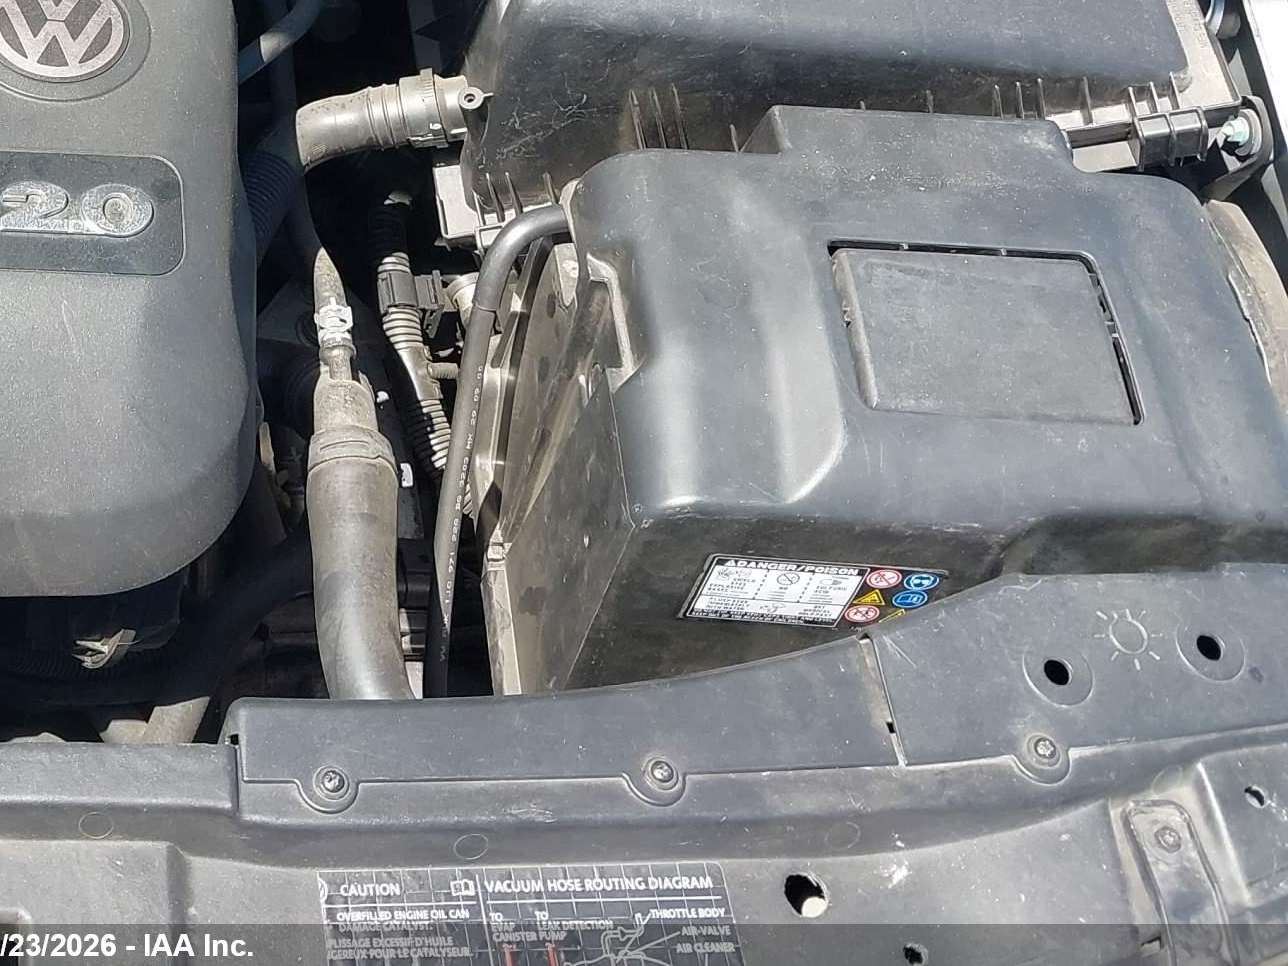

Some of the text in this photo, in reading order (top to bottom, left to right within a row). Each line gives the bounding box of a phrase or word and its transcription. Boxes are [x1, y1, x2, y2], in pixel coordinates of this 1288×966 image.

[736, 560, 859, 576] DANGER/POISON
[340, 883, 401, 896] CAUTION
[484, 876, 713, 892] VACUUM HOSE ROUTING DIAGRAM
[337, 909, 469, 921] OVERFILLED ENGINE OIL CAN
[489, 912, 503, 921] TO
[535, 911, 549, 920] TO
[650, 907, 726, 919] THROTTLE BODY
[339, 922, 382, 932] DAMAGE
[491, 922, 515, 932] EVAP
[536, 919, 614, 931] LEAK DETECTION
[681, 925, 731, 936] AIR-VALVE
[493, 931, 537, 942] CANISTER
[538, 930, 567, 941] PUMP
[676, 942, 736, 953] AIR CLEANER
